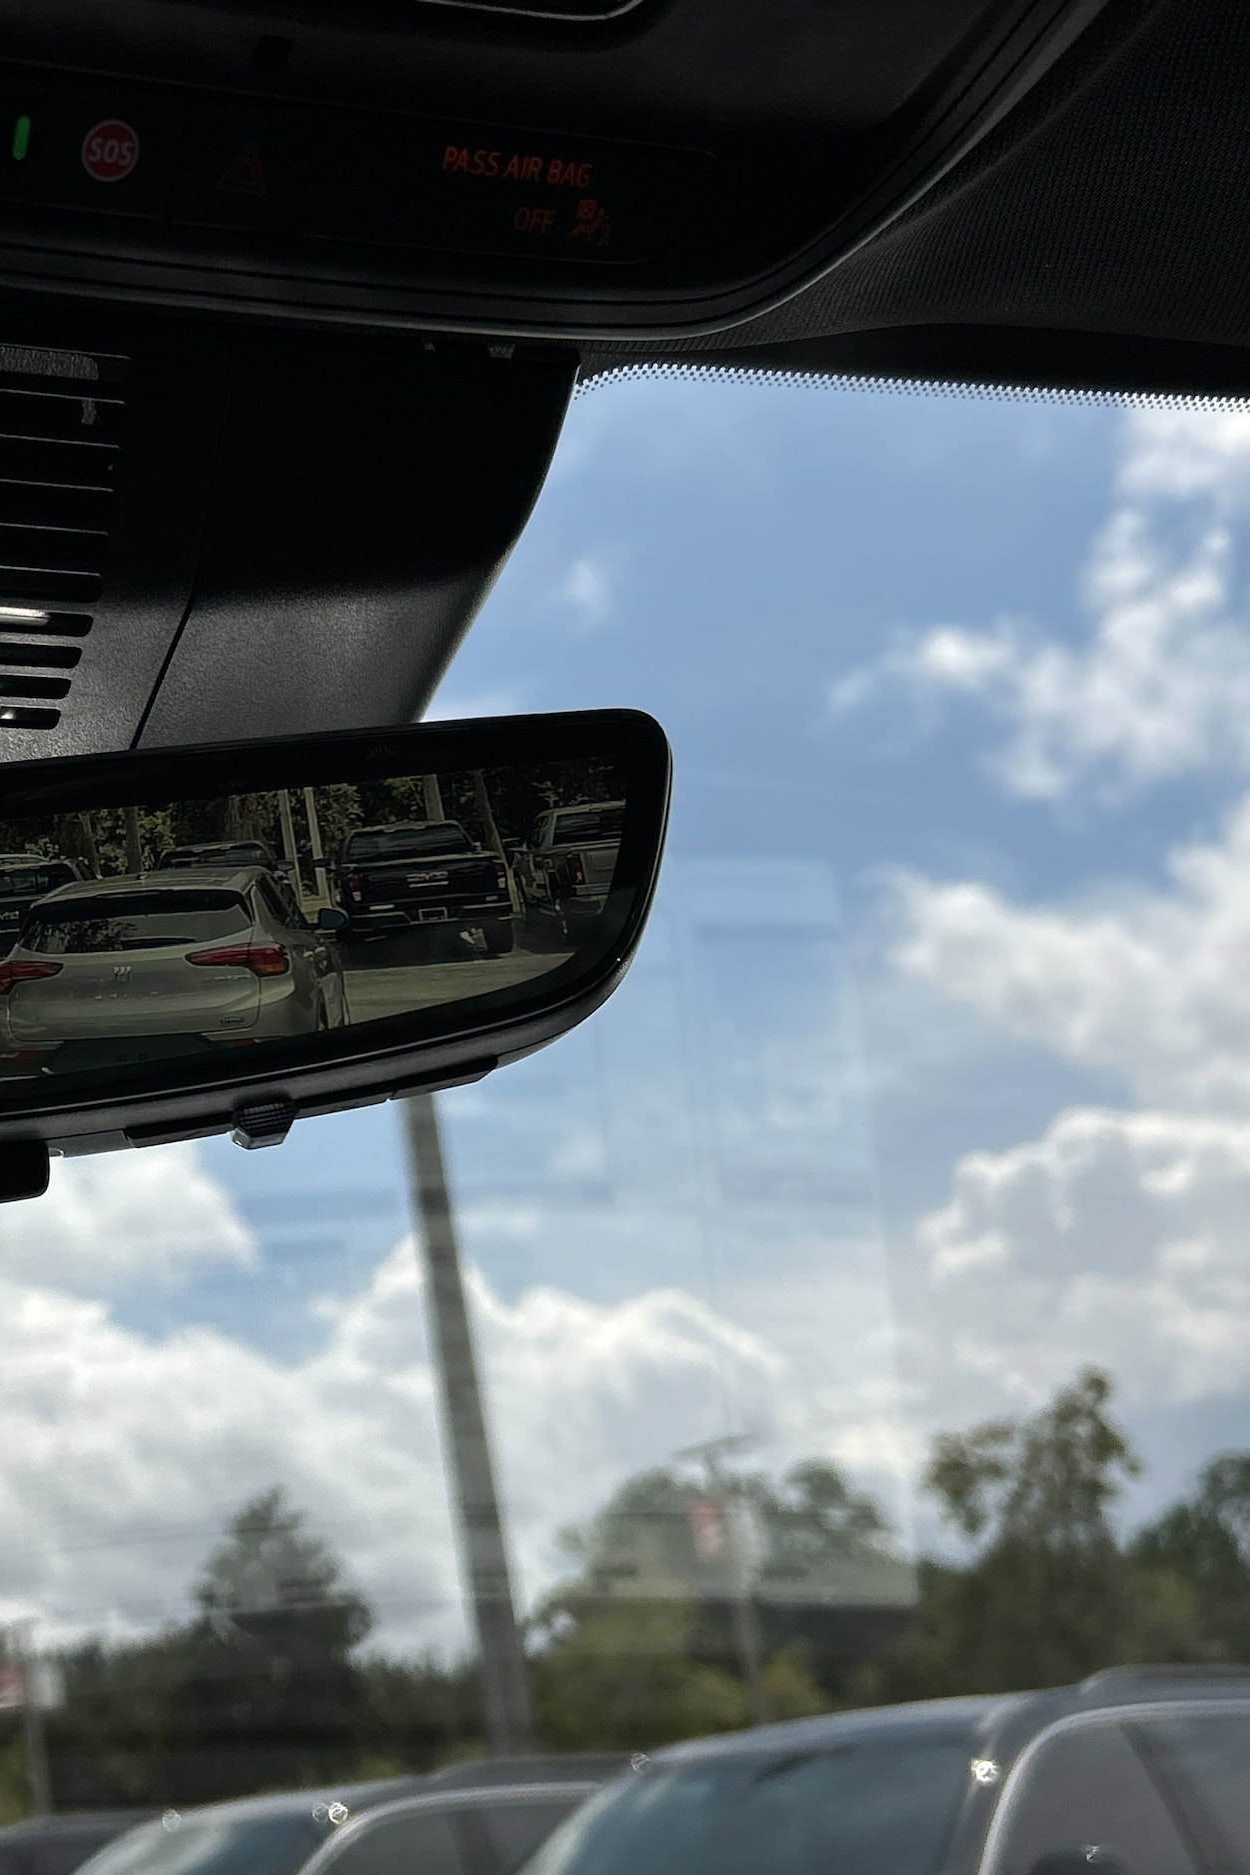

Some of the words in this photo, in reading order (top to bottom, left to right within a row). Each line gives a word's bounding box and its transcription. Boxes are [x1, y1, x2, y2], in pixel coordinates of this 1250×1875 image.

[89, 136, 134, 166] SOS
[442, 144, 502, 177] PASS
[503, 154, 543, 183] AIR
[547, 158, 594, 188] BAG
[513, 206, 558, 233] OFF
